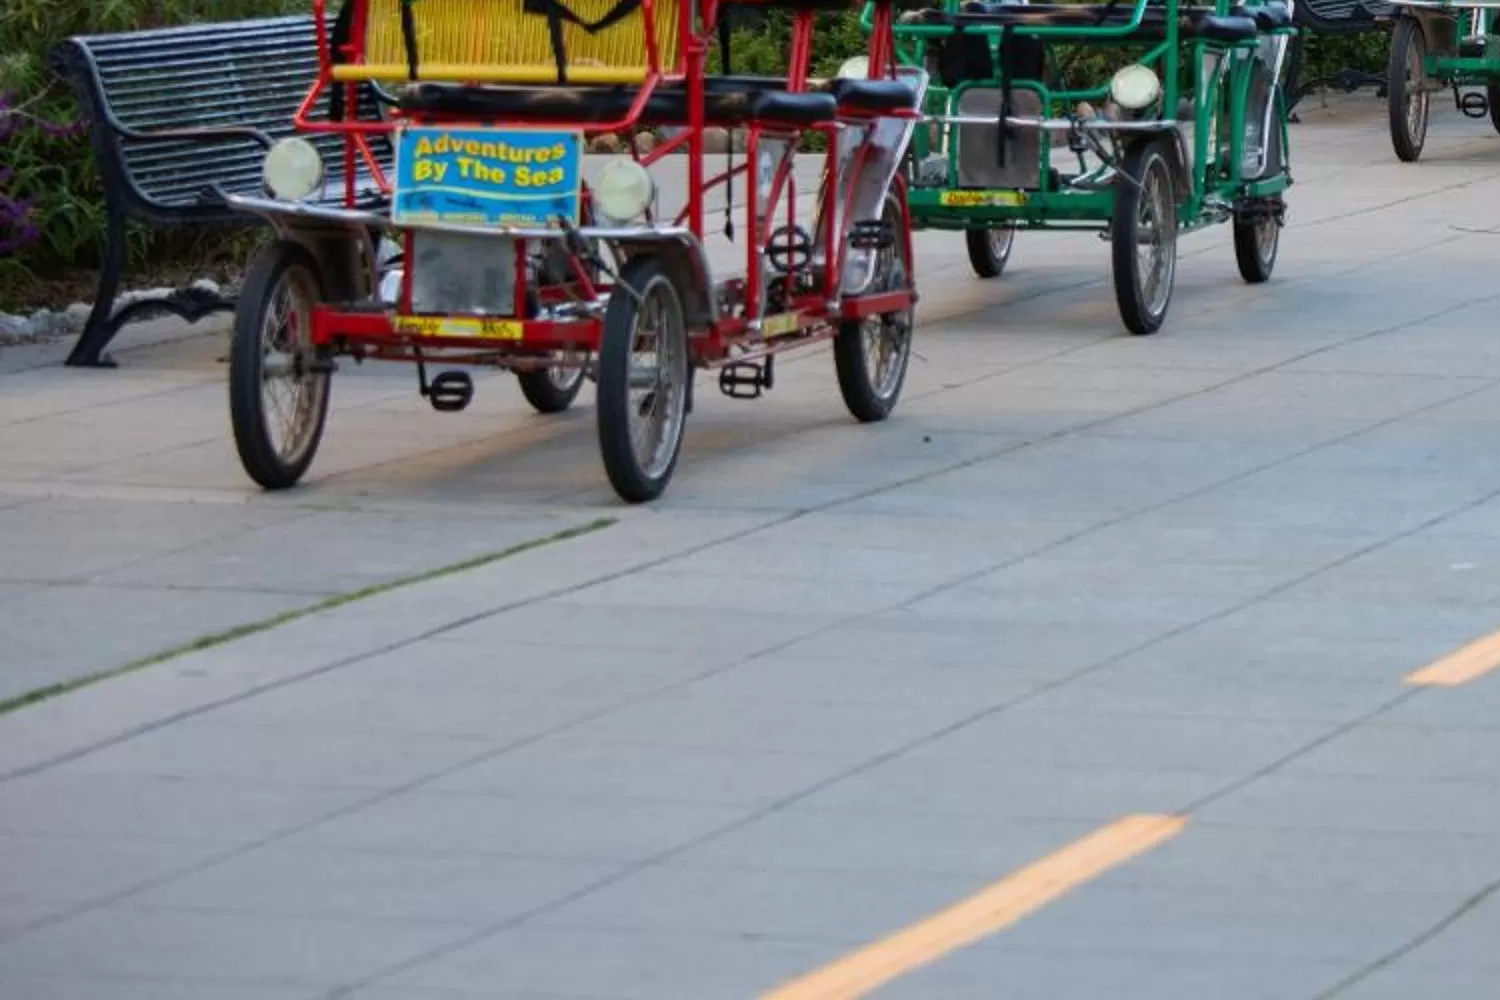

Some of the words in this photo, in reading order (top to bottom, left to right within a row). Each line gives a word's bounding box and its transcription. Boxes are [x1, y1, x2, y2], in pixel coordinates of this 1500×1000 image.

[414, 133, 565, 163] Adventures
[413, 159, 448, 182] By
[456, 157, 505, 184] The
[514, 166, 564, 187] Sea
